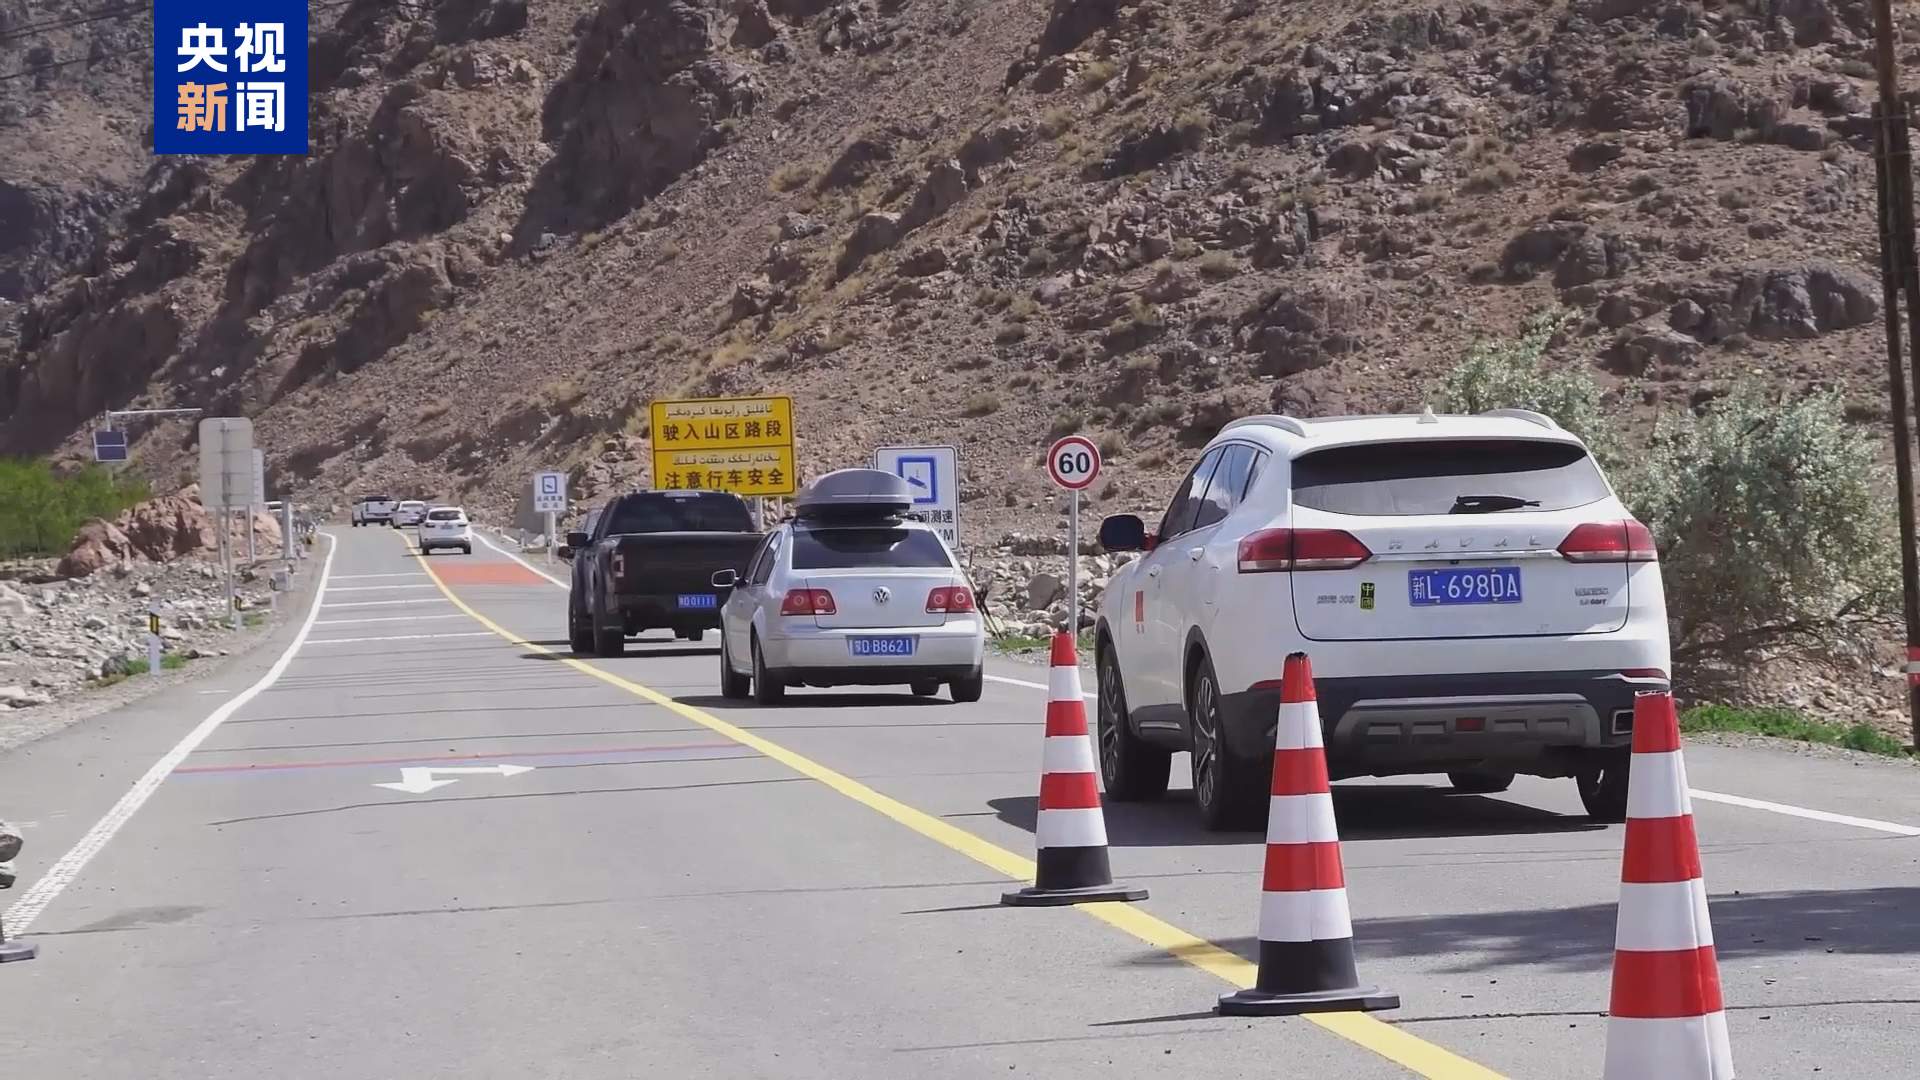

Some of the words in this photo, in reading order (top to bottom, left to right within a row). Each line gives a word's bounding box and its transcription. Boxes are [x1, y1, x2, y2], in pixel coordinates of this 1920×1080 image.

[662, 419, 782, 441] 驶入山区路段
[1058, 451, 1090, 474] 60
[665, 468, 784, 490] 注意行车安全
[1412, 573, 1519, 600] 新L·698DA
